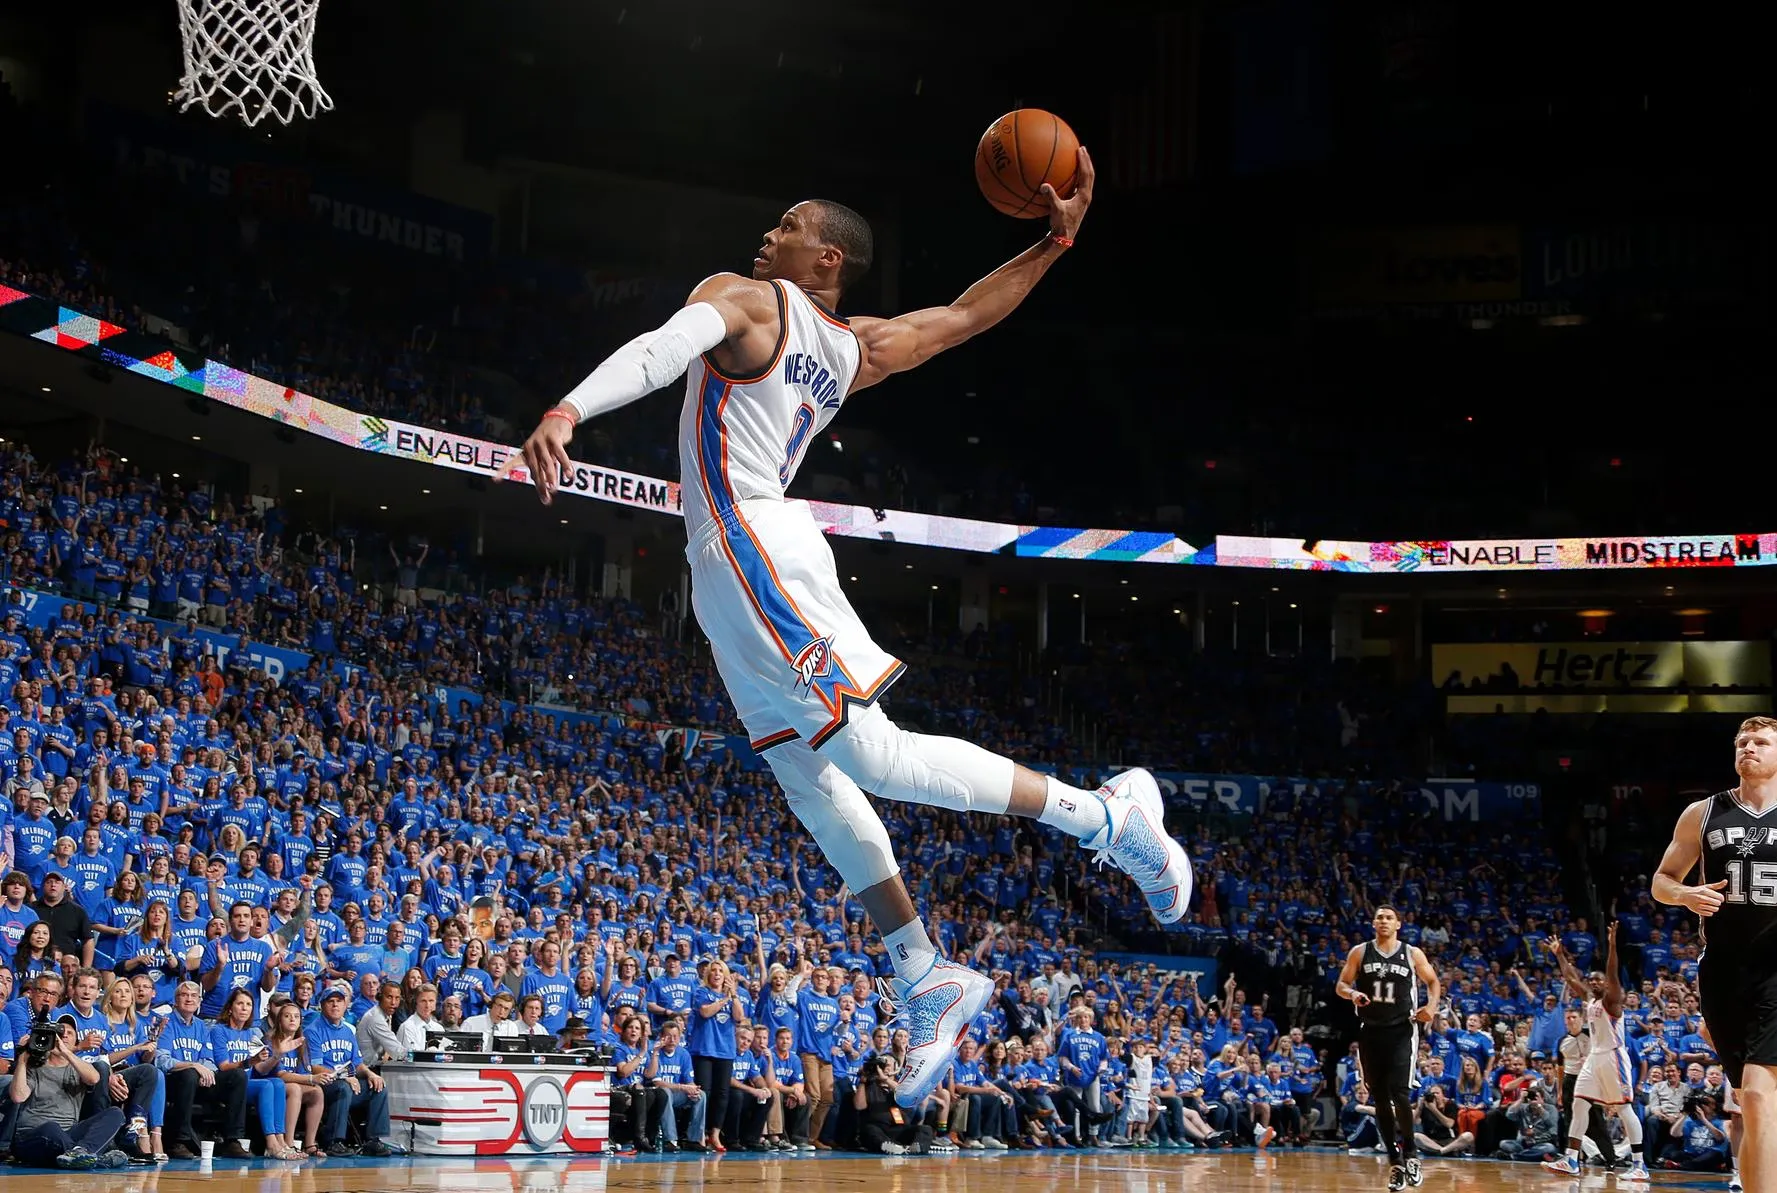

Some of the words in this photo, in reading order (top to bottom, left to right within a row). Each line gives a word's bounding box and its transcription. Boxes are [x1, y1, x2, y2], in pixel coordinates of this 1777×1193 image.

[396, 429, 508, 470] ENABLE
[559, 462, 667, 507] DSTREAM
[1430, 545, 1553, 566] ENABLE
[1586, 540, 1761, 564] MIDSTREAM
[1533, 648, 1659, 682] Hertz
[1504, 784, 1538, 799] 109
[21, 827, 51, 839] OKLAHOMA
[30, 835, 44, 845] CITY
[84, 871, 99, 880] CITY
[1726, 860, 1777, 907] 15
[240, 890, 256, 899] CITY
[233, 963, 250, 973] CITY
[1372, 981, 1395, 1004] 11
[817, 1013, 830, 1021] CITY
[530, 1103, 563, 1124] TNT
